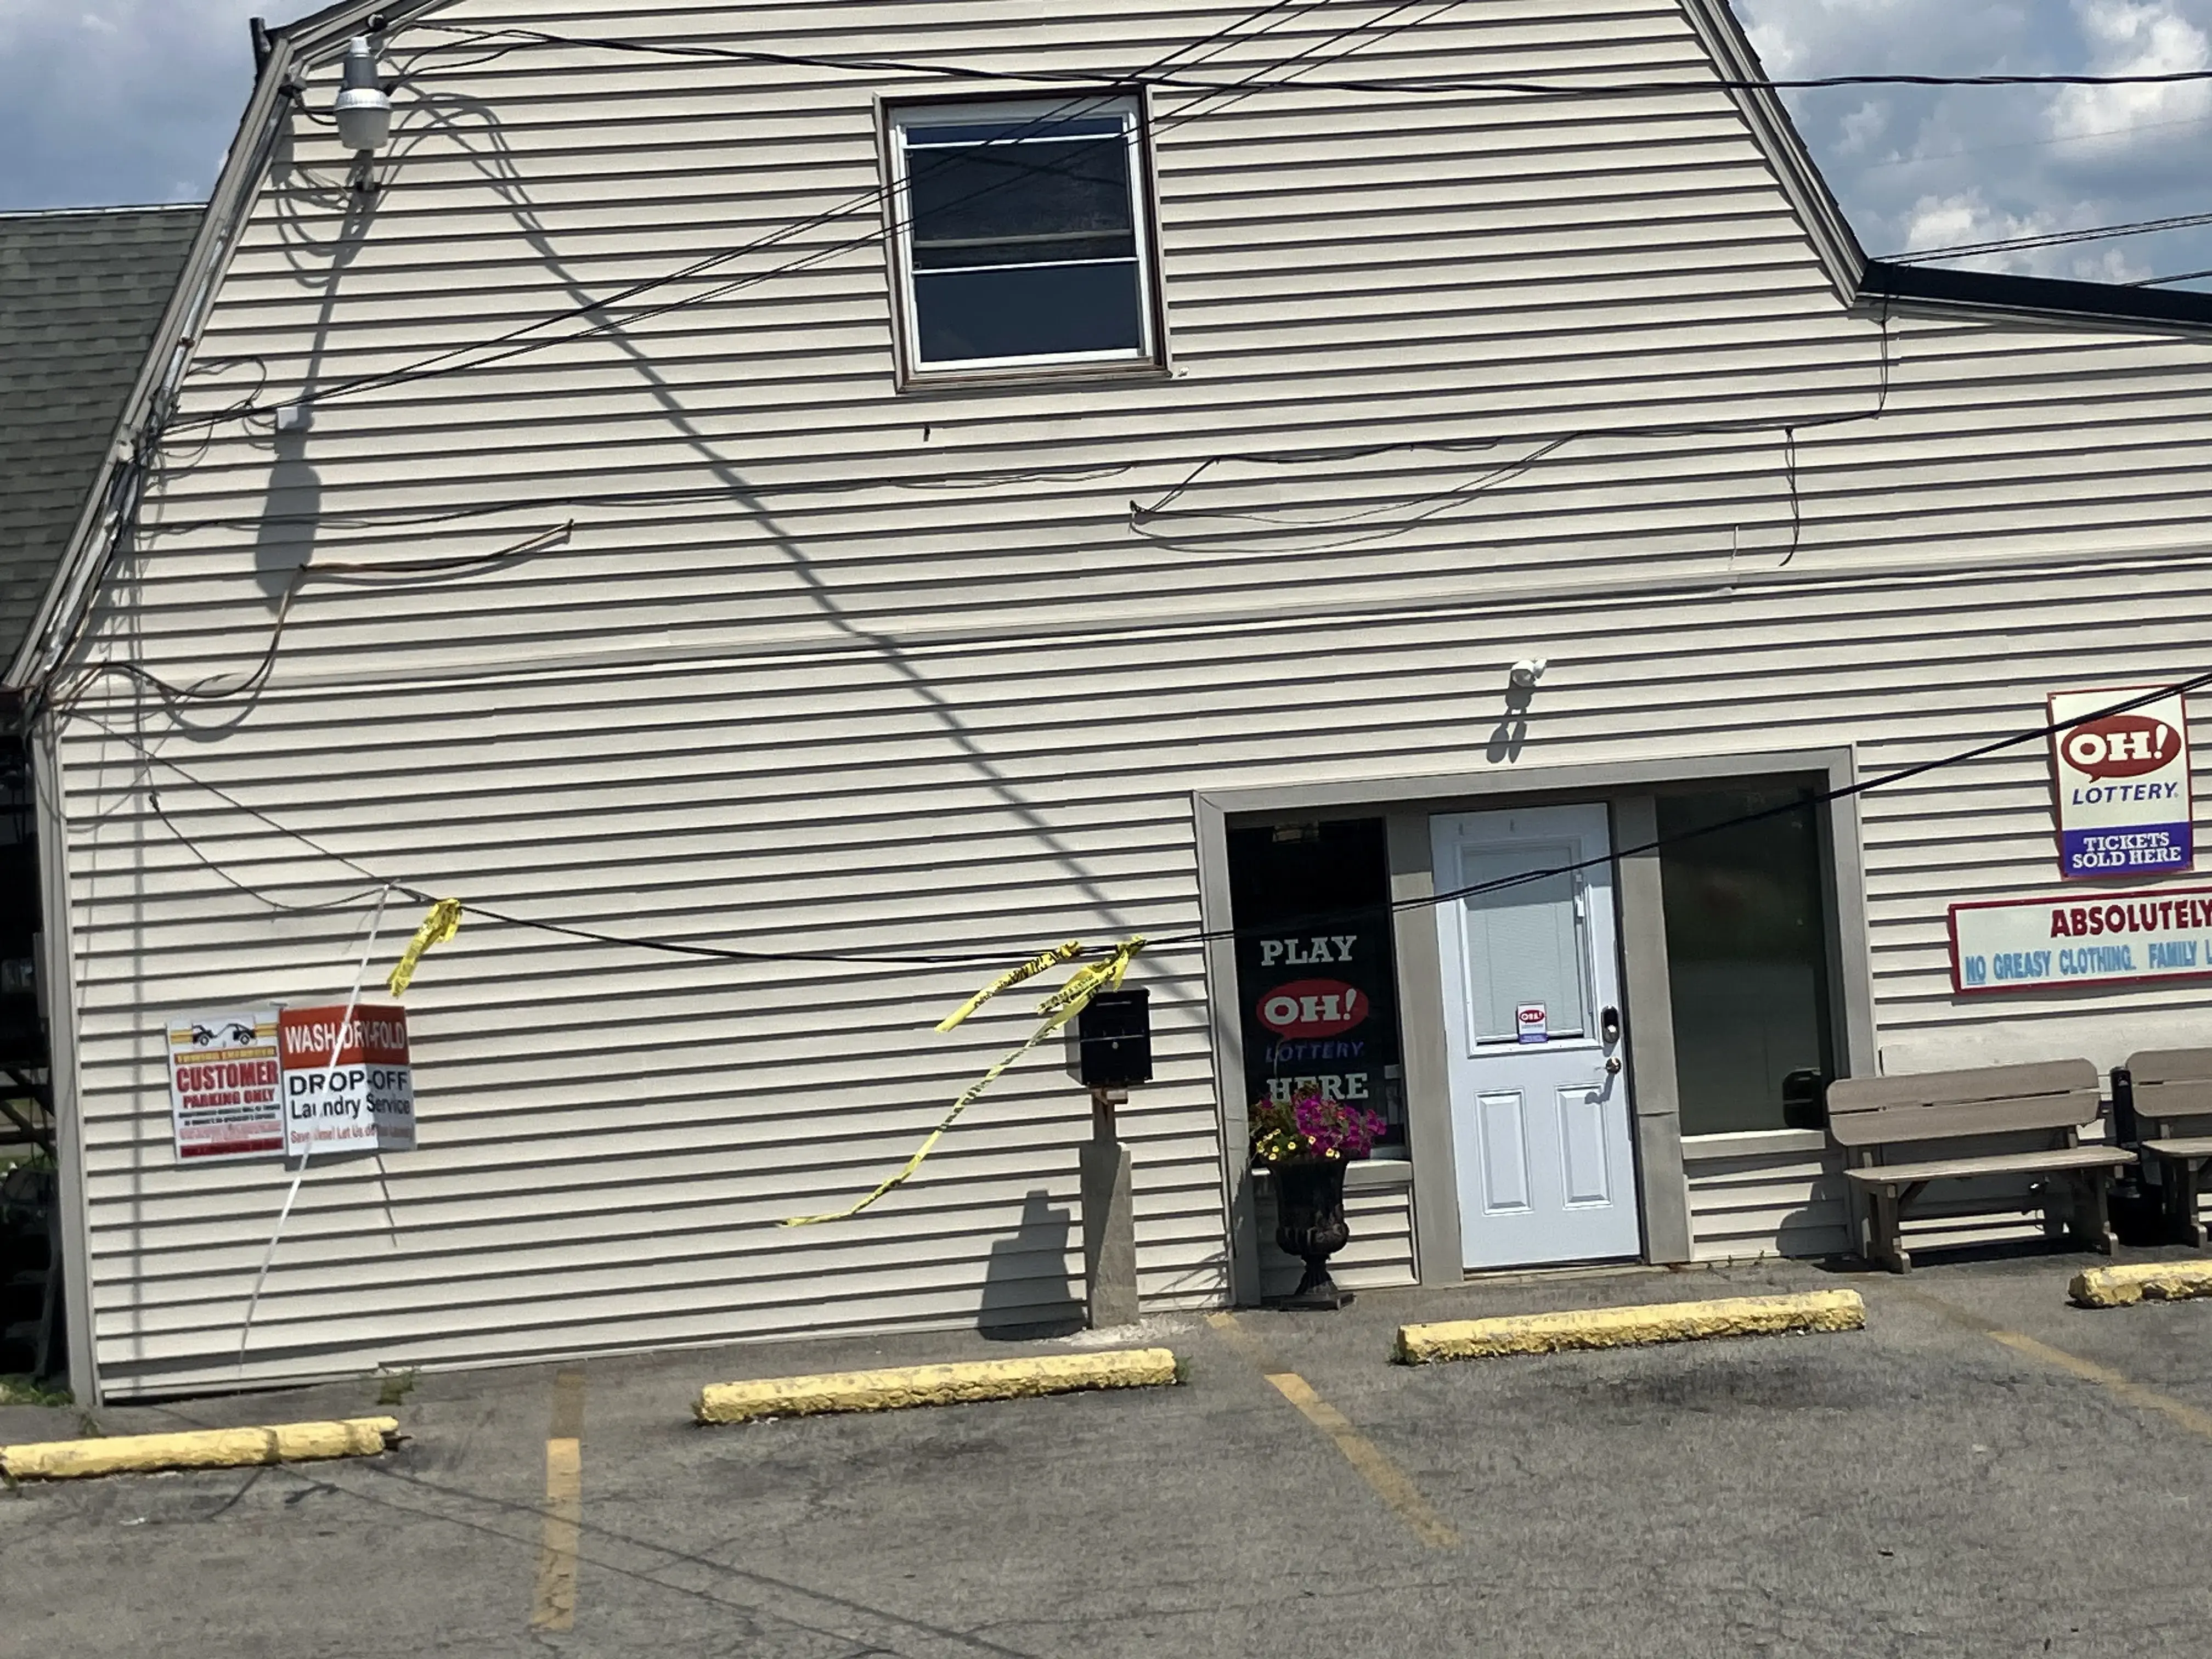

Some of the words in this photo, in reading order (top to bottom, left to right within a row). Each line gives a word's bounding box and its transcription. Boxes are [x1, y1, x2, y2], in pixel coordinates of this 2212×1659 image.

[2069, 724, 2168, 765] OH!
[2072, 782, 2177, 805] LOTTERY
[2083, 832, 2170, 851] TICKETS
[2072, 851, 2125, 868] SOLD
[2129, 847, 2181, 865] HERE
[2051, 899, 2212, 938] ABSOLUTELY
[1261, 935, 1357, 966] PLAY
[1965, 955, 1986, 981] NO
[1993, 951, 2052, 980] GREASY
[2148, 940, 2197, 969] FAMILY
[1264, 988, 1356, 1025] OH!
[1265, 1041, 1364, 1063] LOTTERY
[176, 1060, 279, 1092] CUSTOMER
[289, 1070, 407, 1096] DROP-OFF
[183, 1091, 241, 1108] PARKING
[244, 1088, 275, 1104] ONLY
[291, 1095, 361, 1119] Landry
[366, 1093, 410, 1115] Service
